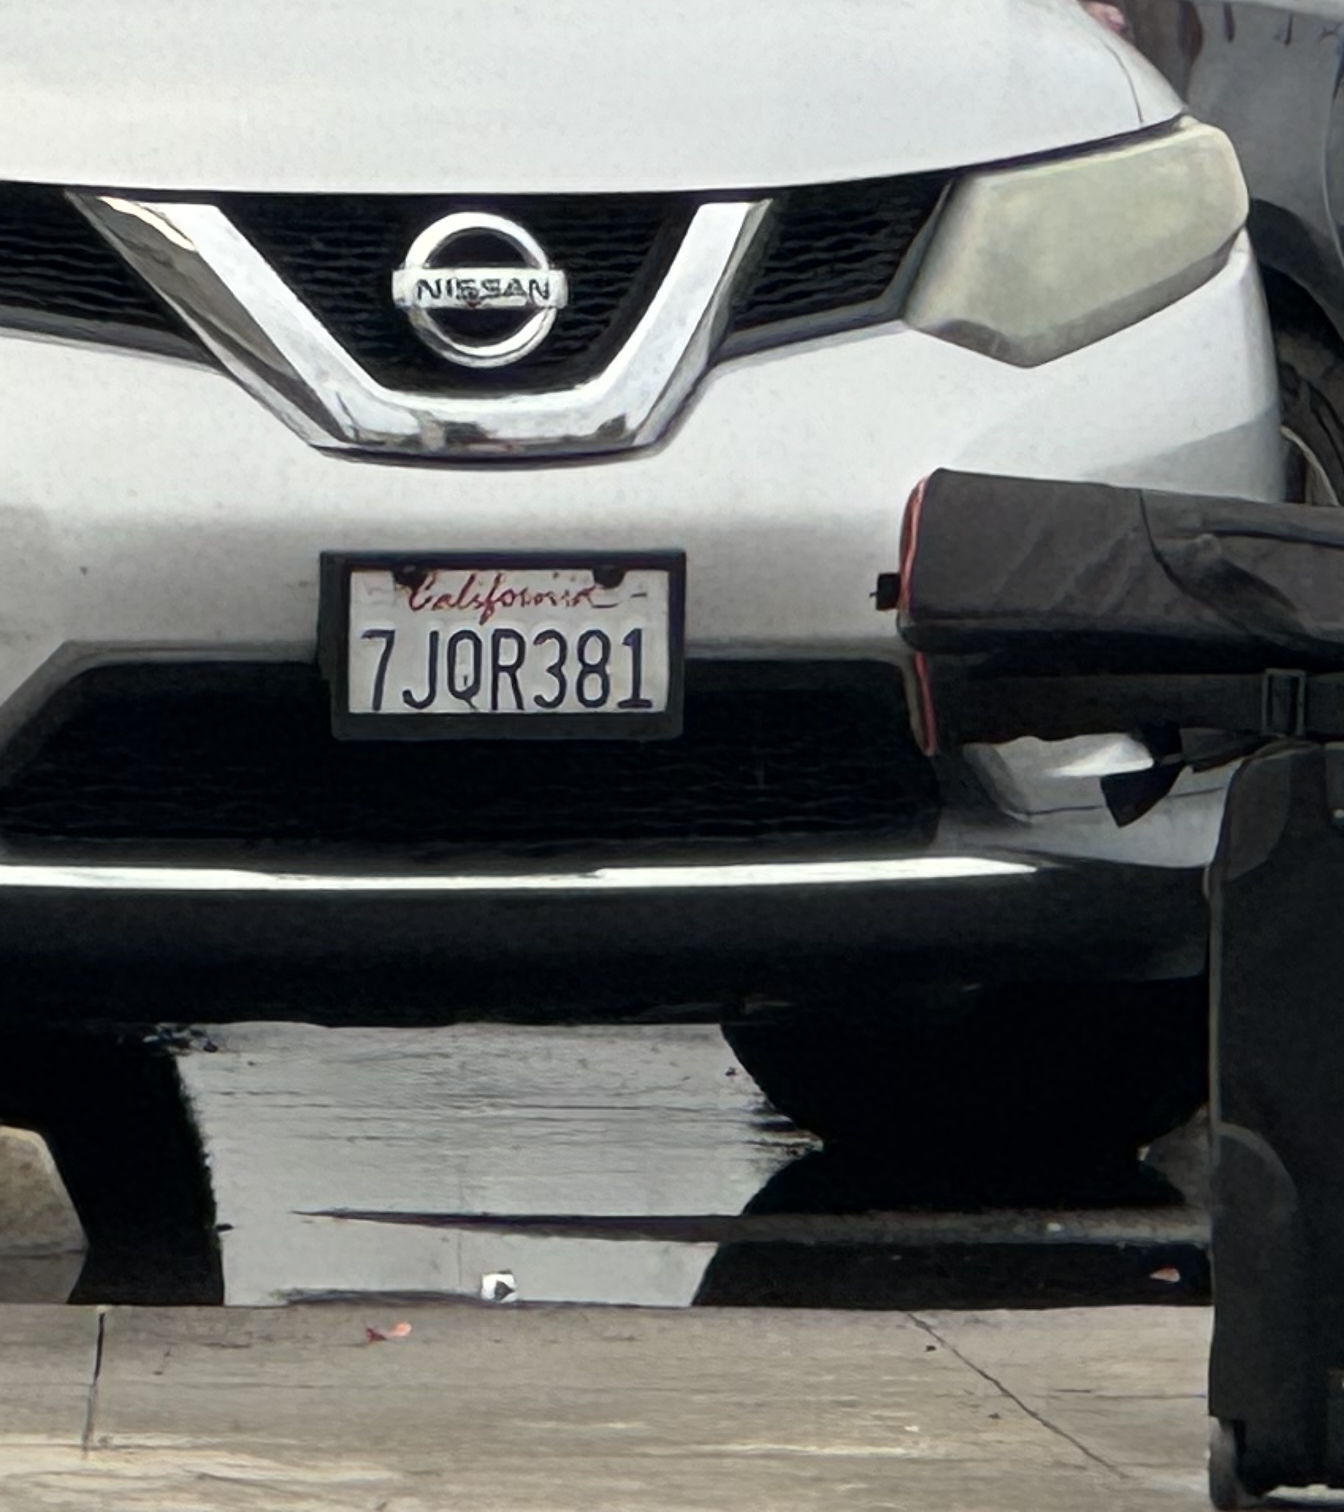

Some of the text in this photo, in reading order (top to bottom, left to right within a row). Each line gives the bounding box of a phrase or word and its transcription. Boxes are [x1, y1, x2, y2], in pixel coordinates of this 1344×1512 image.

[416, 277, 550, 301] NISSAN
[408, 572, 617, 626] California
[360, 627, 653, 713] 7JQR381
